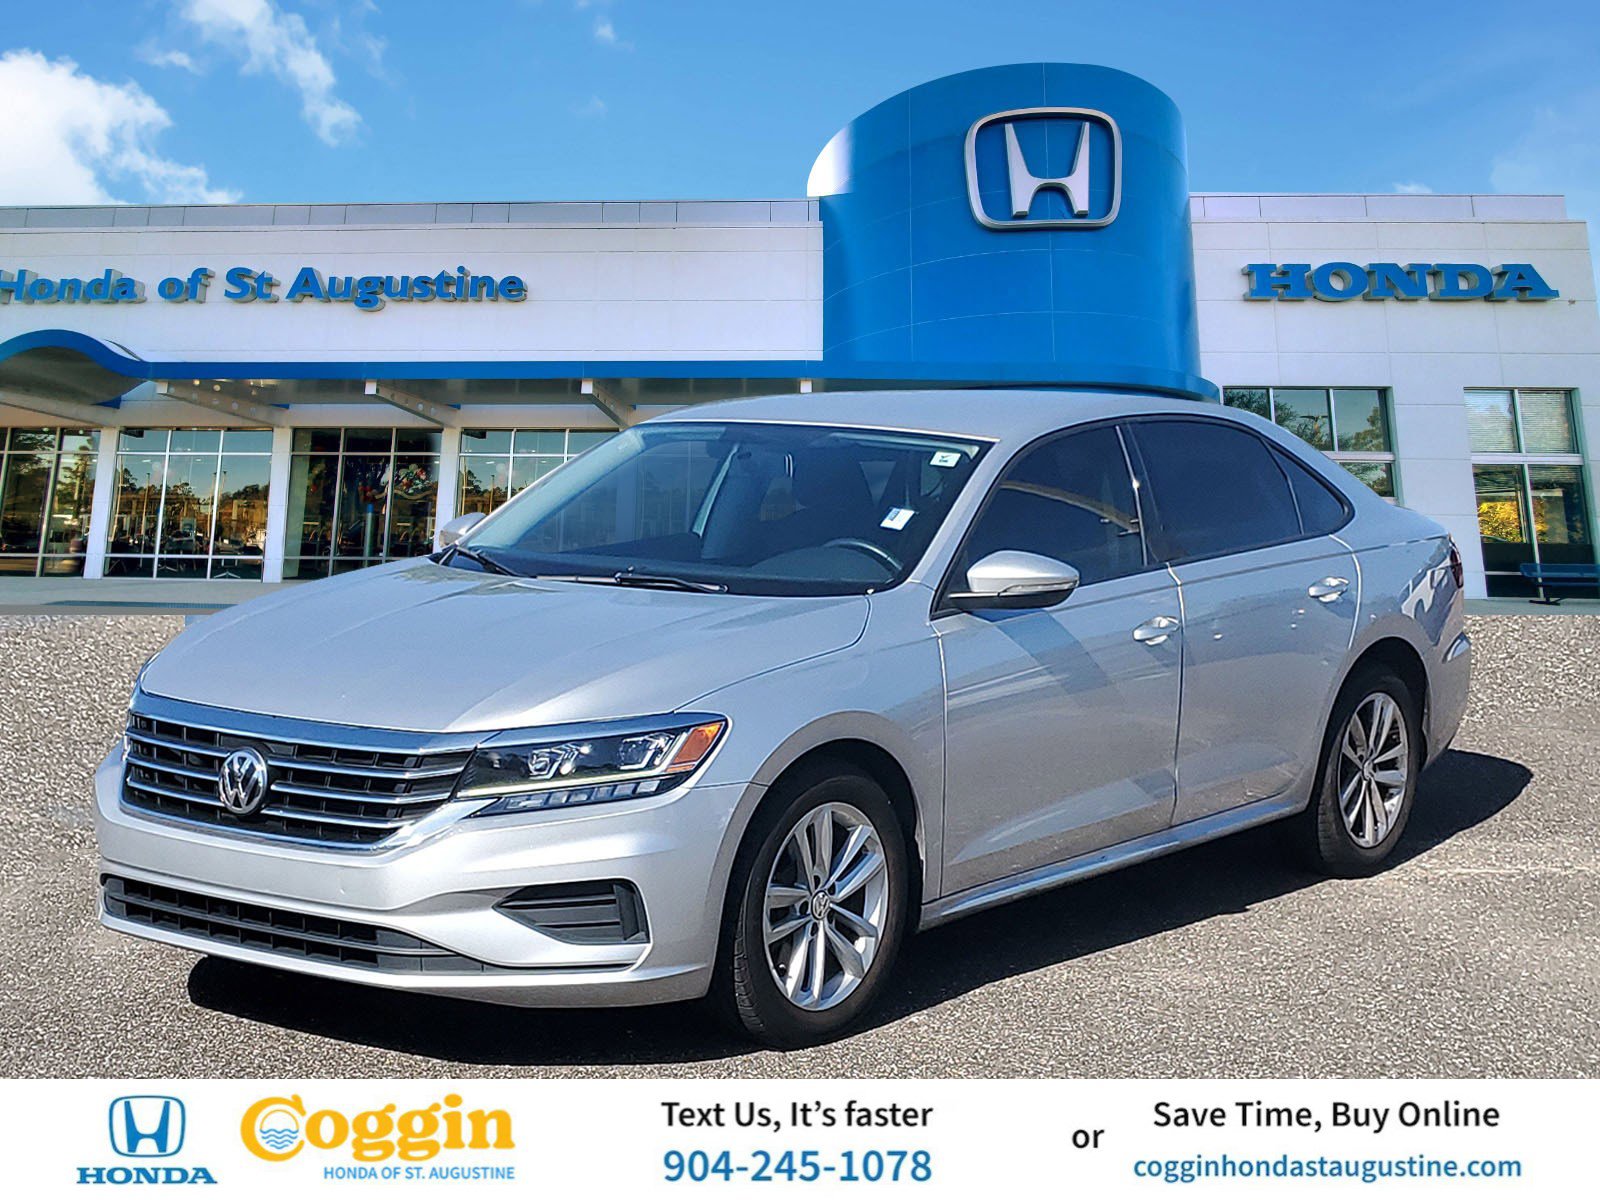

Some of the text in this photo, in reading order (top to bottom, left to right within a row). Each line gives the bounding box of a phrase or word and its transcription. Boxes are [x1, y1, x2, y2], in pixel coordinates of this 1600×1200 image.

[0, 265, 527, 311] Honda of St Augustine
[1243, 262, 1560, 301] HONDA
